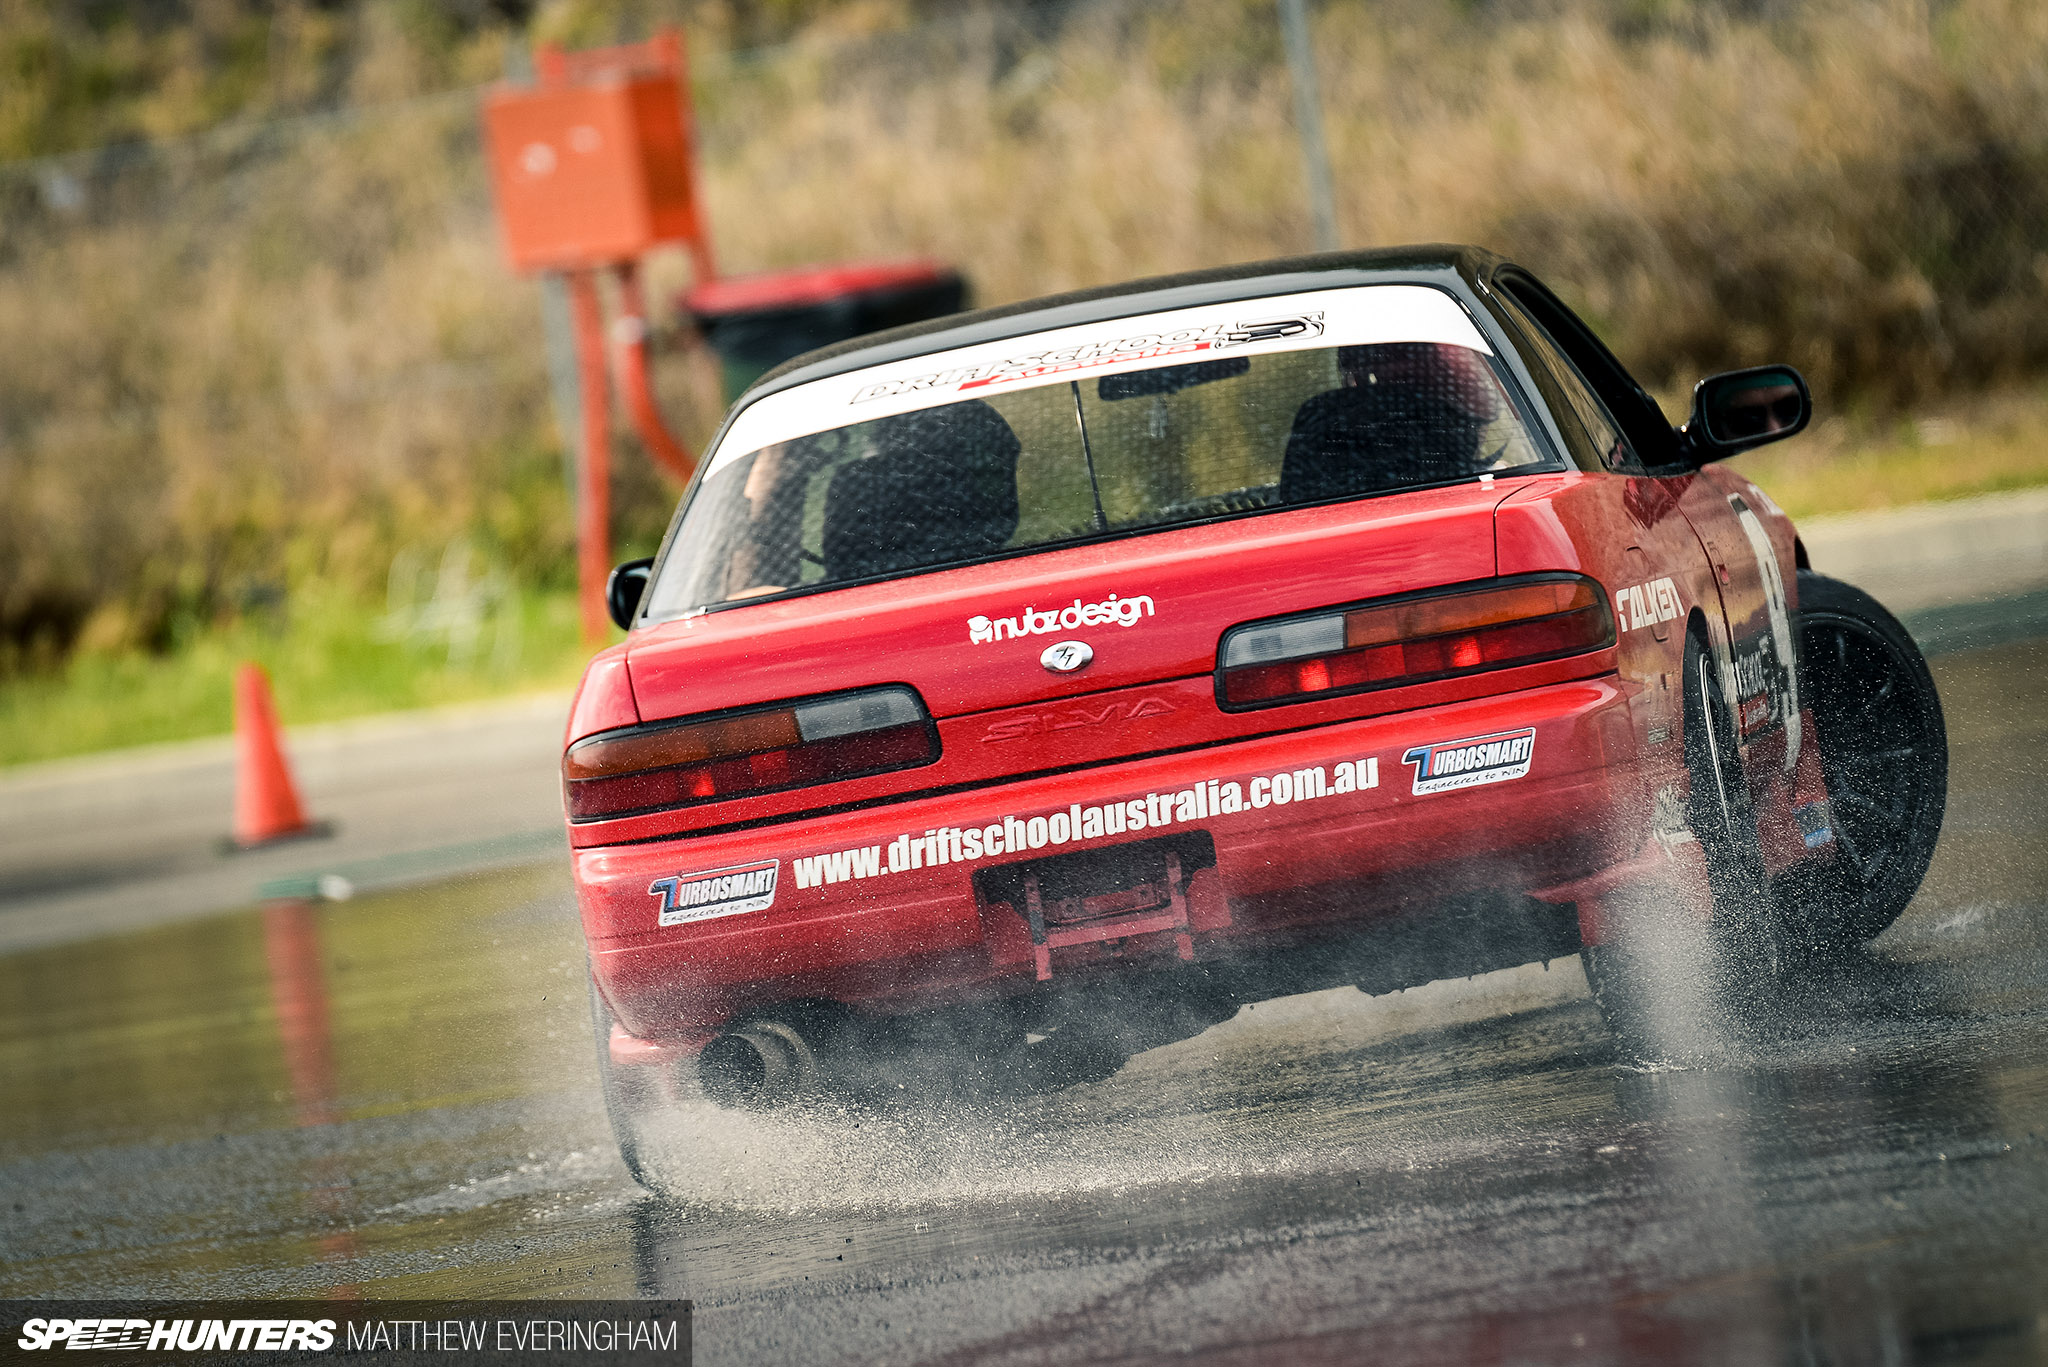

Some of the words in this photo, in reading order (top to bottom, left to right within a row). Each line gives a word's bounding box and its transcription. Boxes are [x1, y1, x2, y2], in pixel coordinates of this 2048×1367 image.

[1406, 734, 1532, 780] TURBOSMART
[793, 756, 1379, 890] www.driftschoolaustralia.com.au
[652, 867, 776, 912] TURBOSMART
